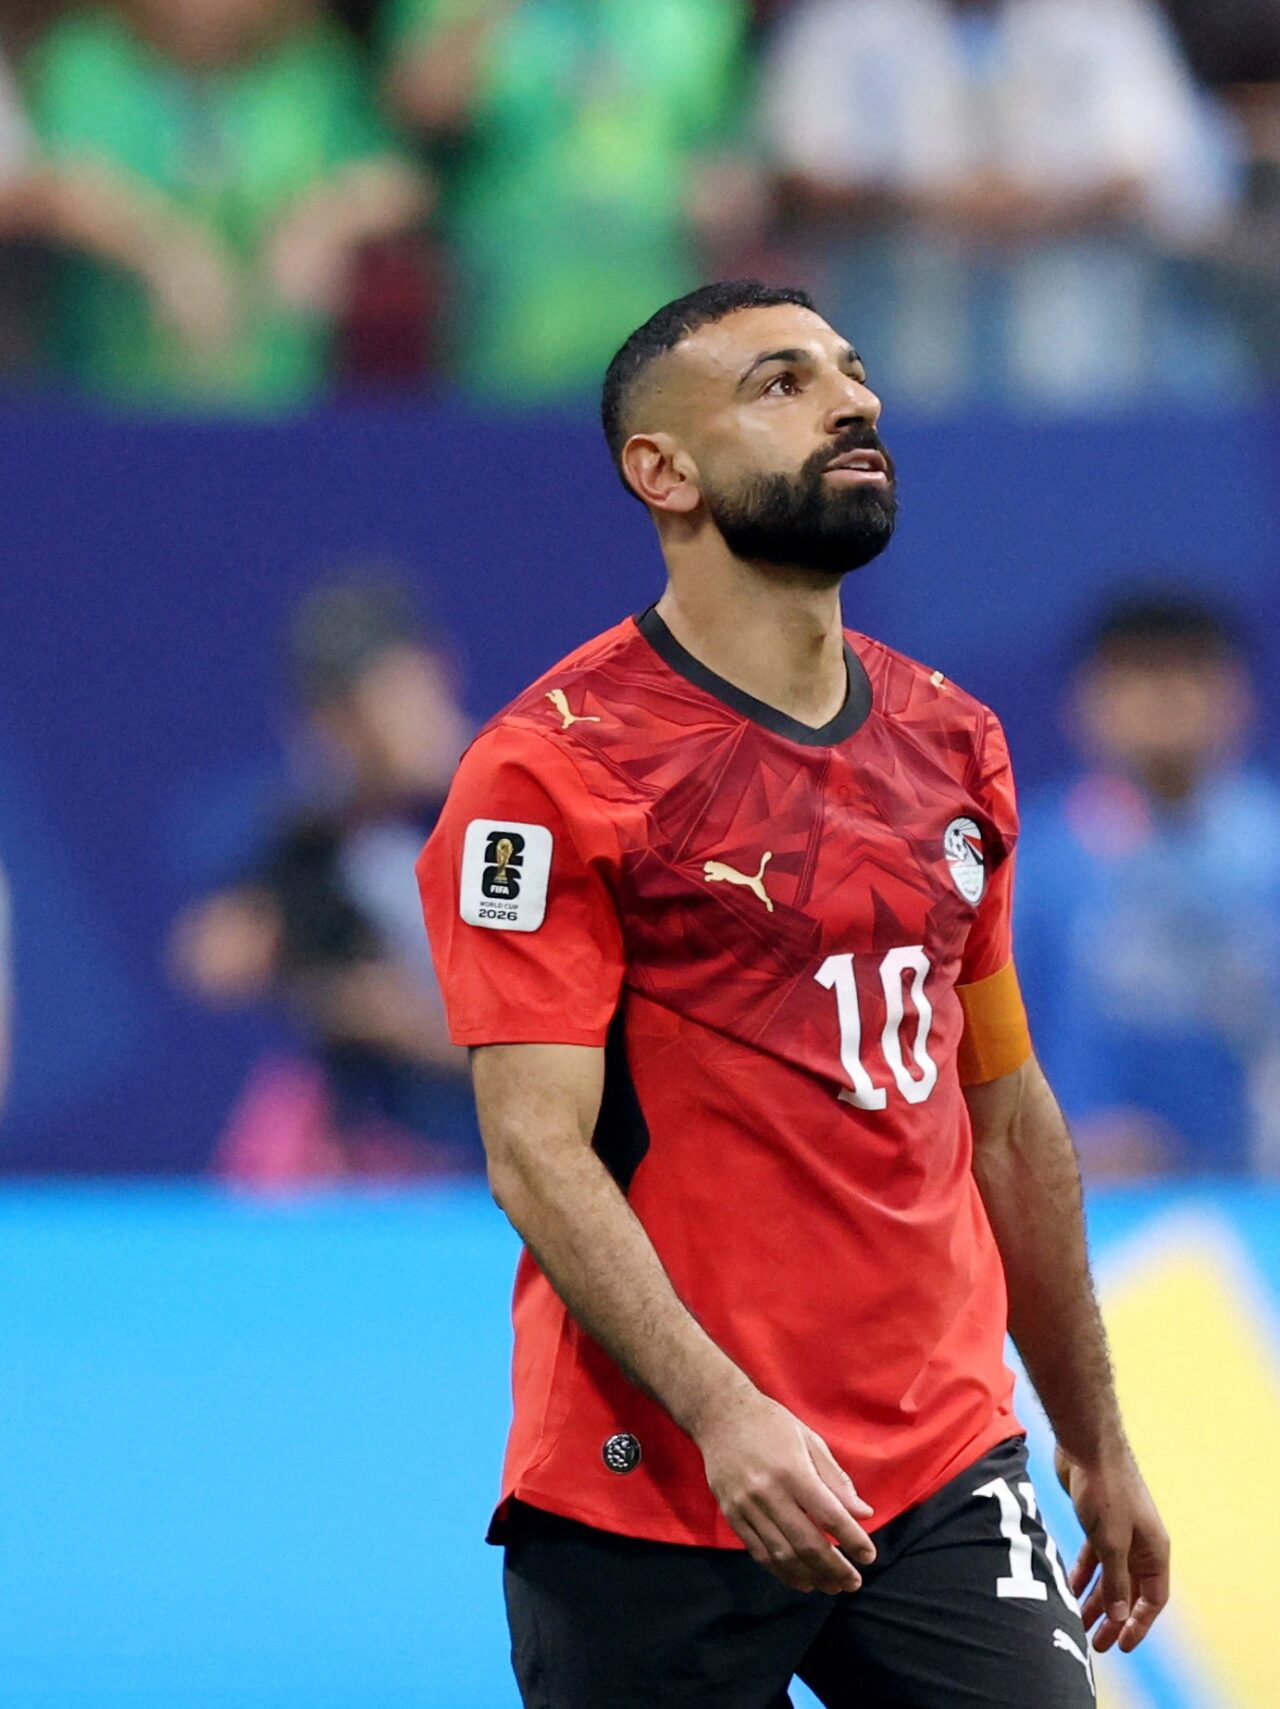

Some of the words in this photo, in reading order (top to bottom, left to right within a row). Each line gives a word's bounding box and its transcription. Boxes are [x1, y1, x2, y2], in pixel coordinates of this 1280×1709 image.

[490, 884, 510, 895] FIFA
[480, 901, 503, 909] WORLD
[504, 902, 519, 910] CUP
[478, 908, 518, 921] 2026
[813, 945, 939, 1111] 10
